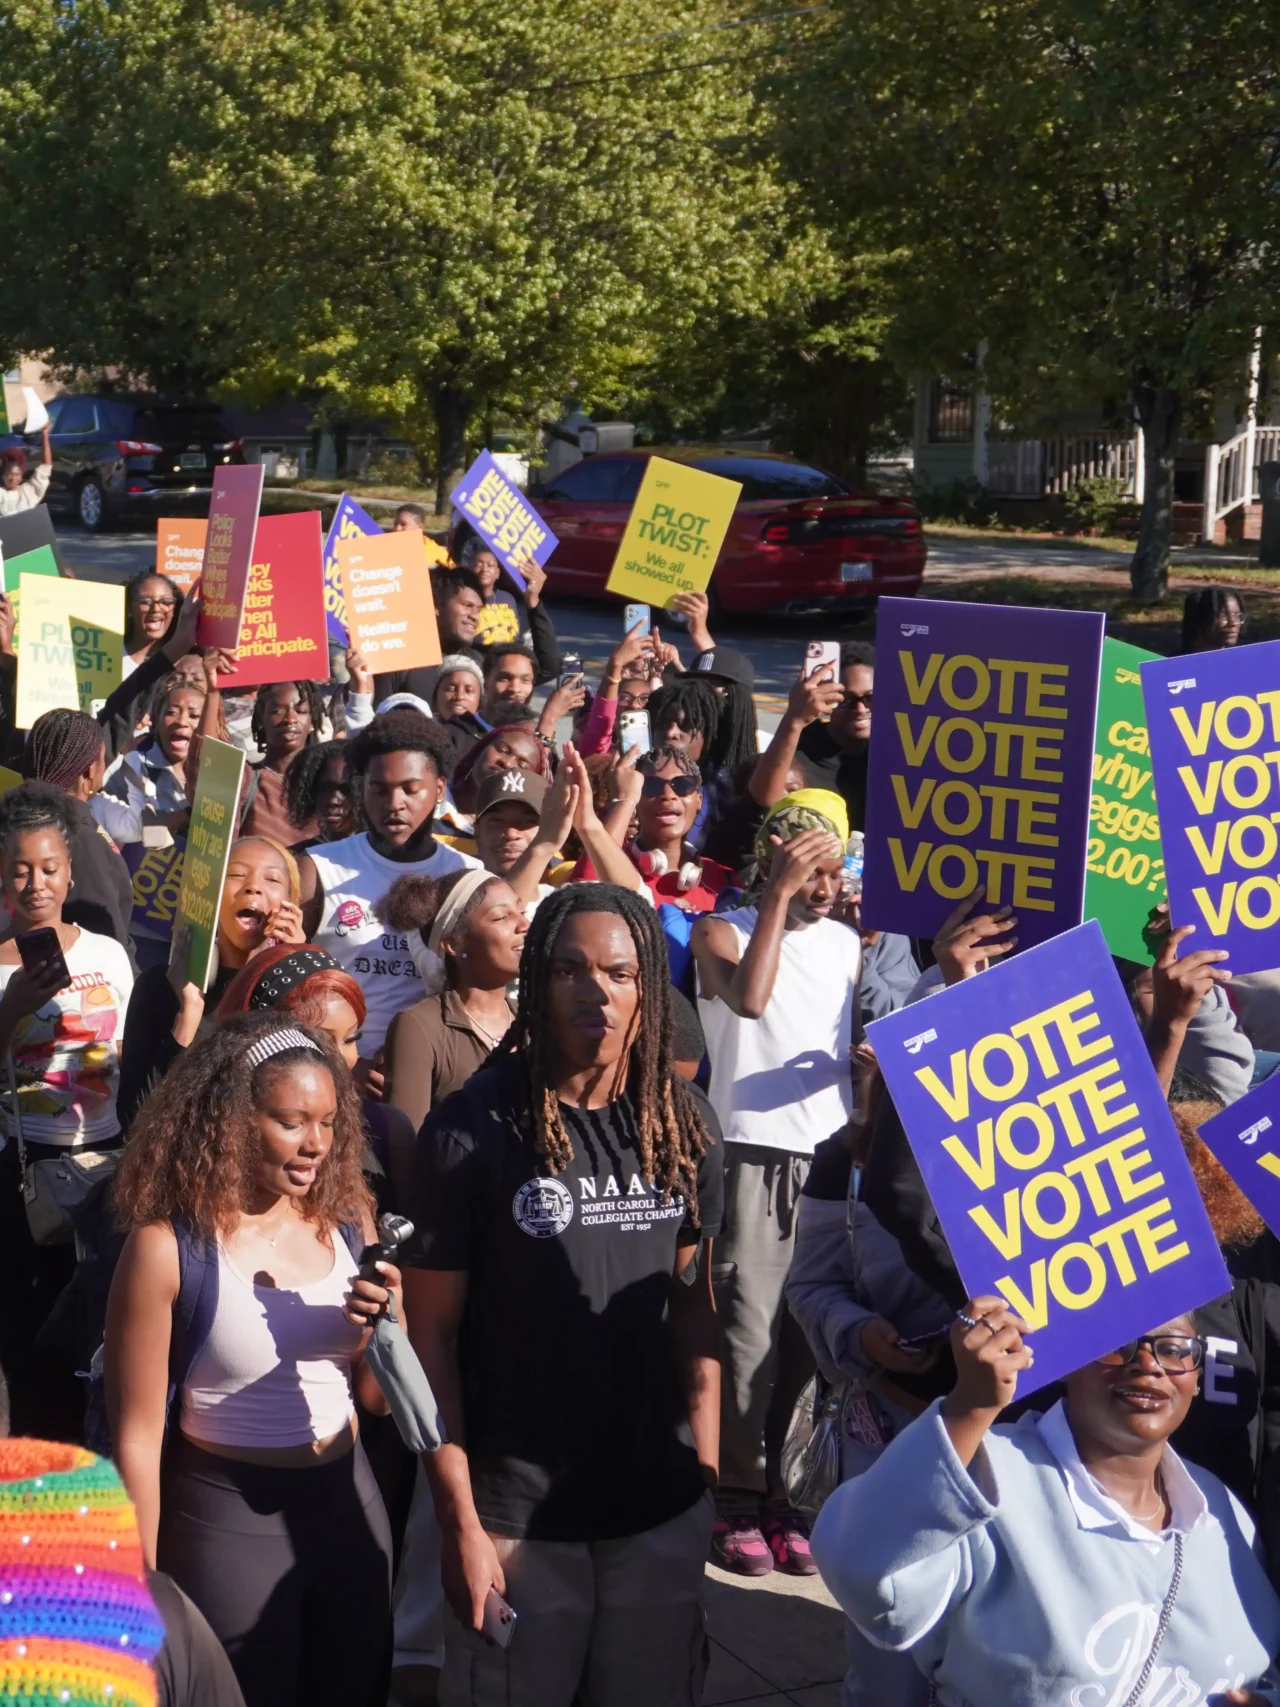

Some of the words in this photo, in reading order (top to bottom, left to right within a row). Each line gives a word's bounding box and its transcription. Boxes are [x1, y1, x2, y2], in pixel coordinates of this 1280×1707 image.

[465, 468, 505, 517] VOTE
[478, 485, 519, 535] VOTE
[651, 503, 710, 535] PLOT
[492, 502, 533, 553] VOTE
[639, 518, 711, 559] TWIST:
[165, 545, 205, 560] Chang
[646, 551, 667, 569] We
[668, 562, 685, 574] all
[349, 565, 403, 582] Change
[624, 560, 675, 584] showed
[676, 580, 695, 592] up.
[354, 598, 387, 613] wait.
[41, 621, 104, 649] PLOT
[255, 623, 277, 640] All
[358, 620, 408, 638] Neither
[28, 642, 112, 673] TWIST:
[232, 636, 318, 658] articipate.
[361, 639, 380, 653] do
[382, 637, 406, 650] we.
[78, 681, 92, 694] all
[898, 650, 1069, 720] VOTE
[1170, 691, 1280, 756] VOT
[894, 711, 1064, 783] VOTE
[502, 771, 525, 792] NY
[201, 796, 226, 826] cause
[890, 774, 1060, 847] VOTE
[192, 822, 209, 856] why
[208, 837, 223, 859] are
[191, 858, 212, 890] eggs
[887, 837, 1055, 912] VOTE
[354, 957, 422, 979] DREA
[914, 989, 1114, 1123] VOTE
[940, 1058, 1140, 1191] VOTE
[581, 1201, 615, 1214] NORTH
[967, 1127, 1165, 1261] VOTE
[581, 1211, 644, 1225] COLLEGIATE
[621, 1223, 635, 1231] EST
[636, 1223, 651, 1231] 1952
[994, 1197, 1191, 1330] VOTE
